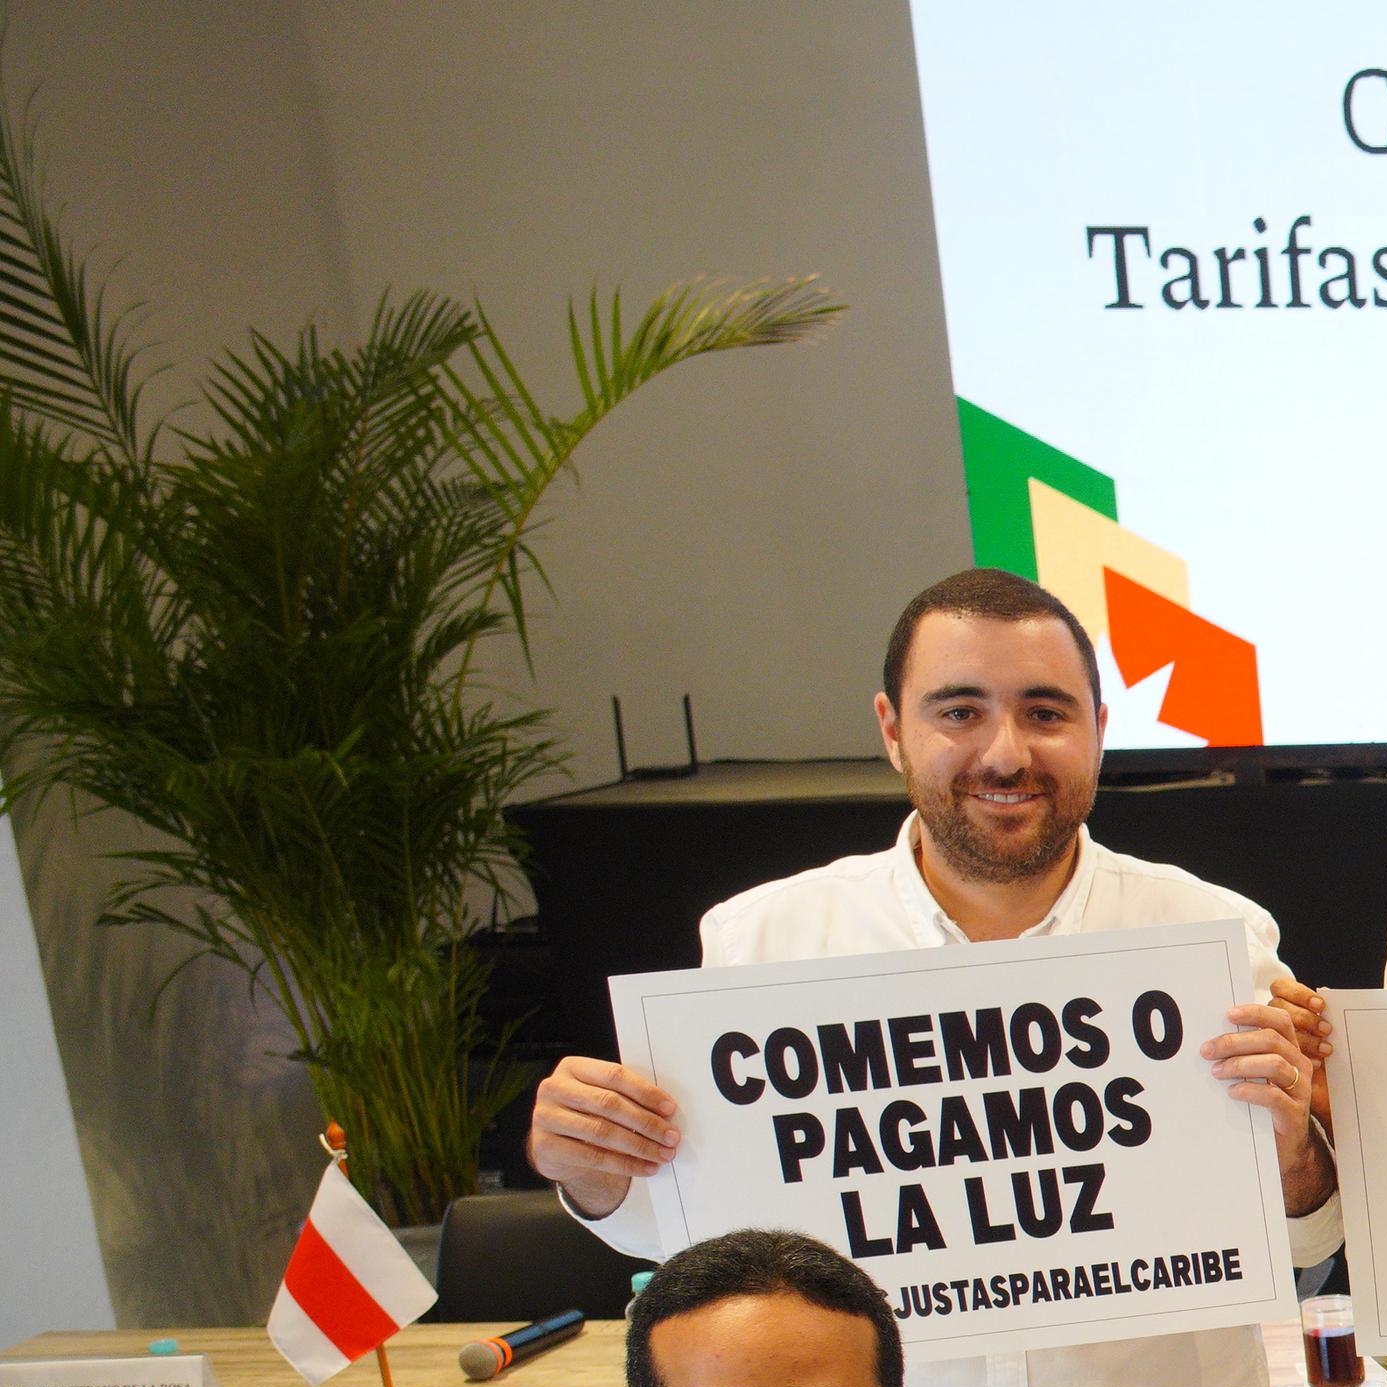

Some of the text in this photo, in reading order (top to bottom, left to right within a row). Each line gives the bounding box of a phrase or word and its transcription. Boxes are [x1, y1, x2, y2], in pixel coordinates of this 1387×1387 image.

[711, 990, 1183, 1105] COMEMOS O
[773, 1077, 1151, 1183] PAGAMOS
[841, 1163, 1114, 1259] LA LUZ
[894, 1248, 1242, 1317] JUSTASPARAELCARIBE
